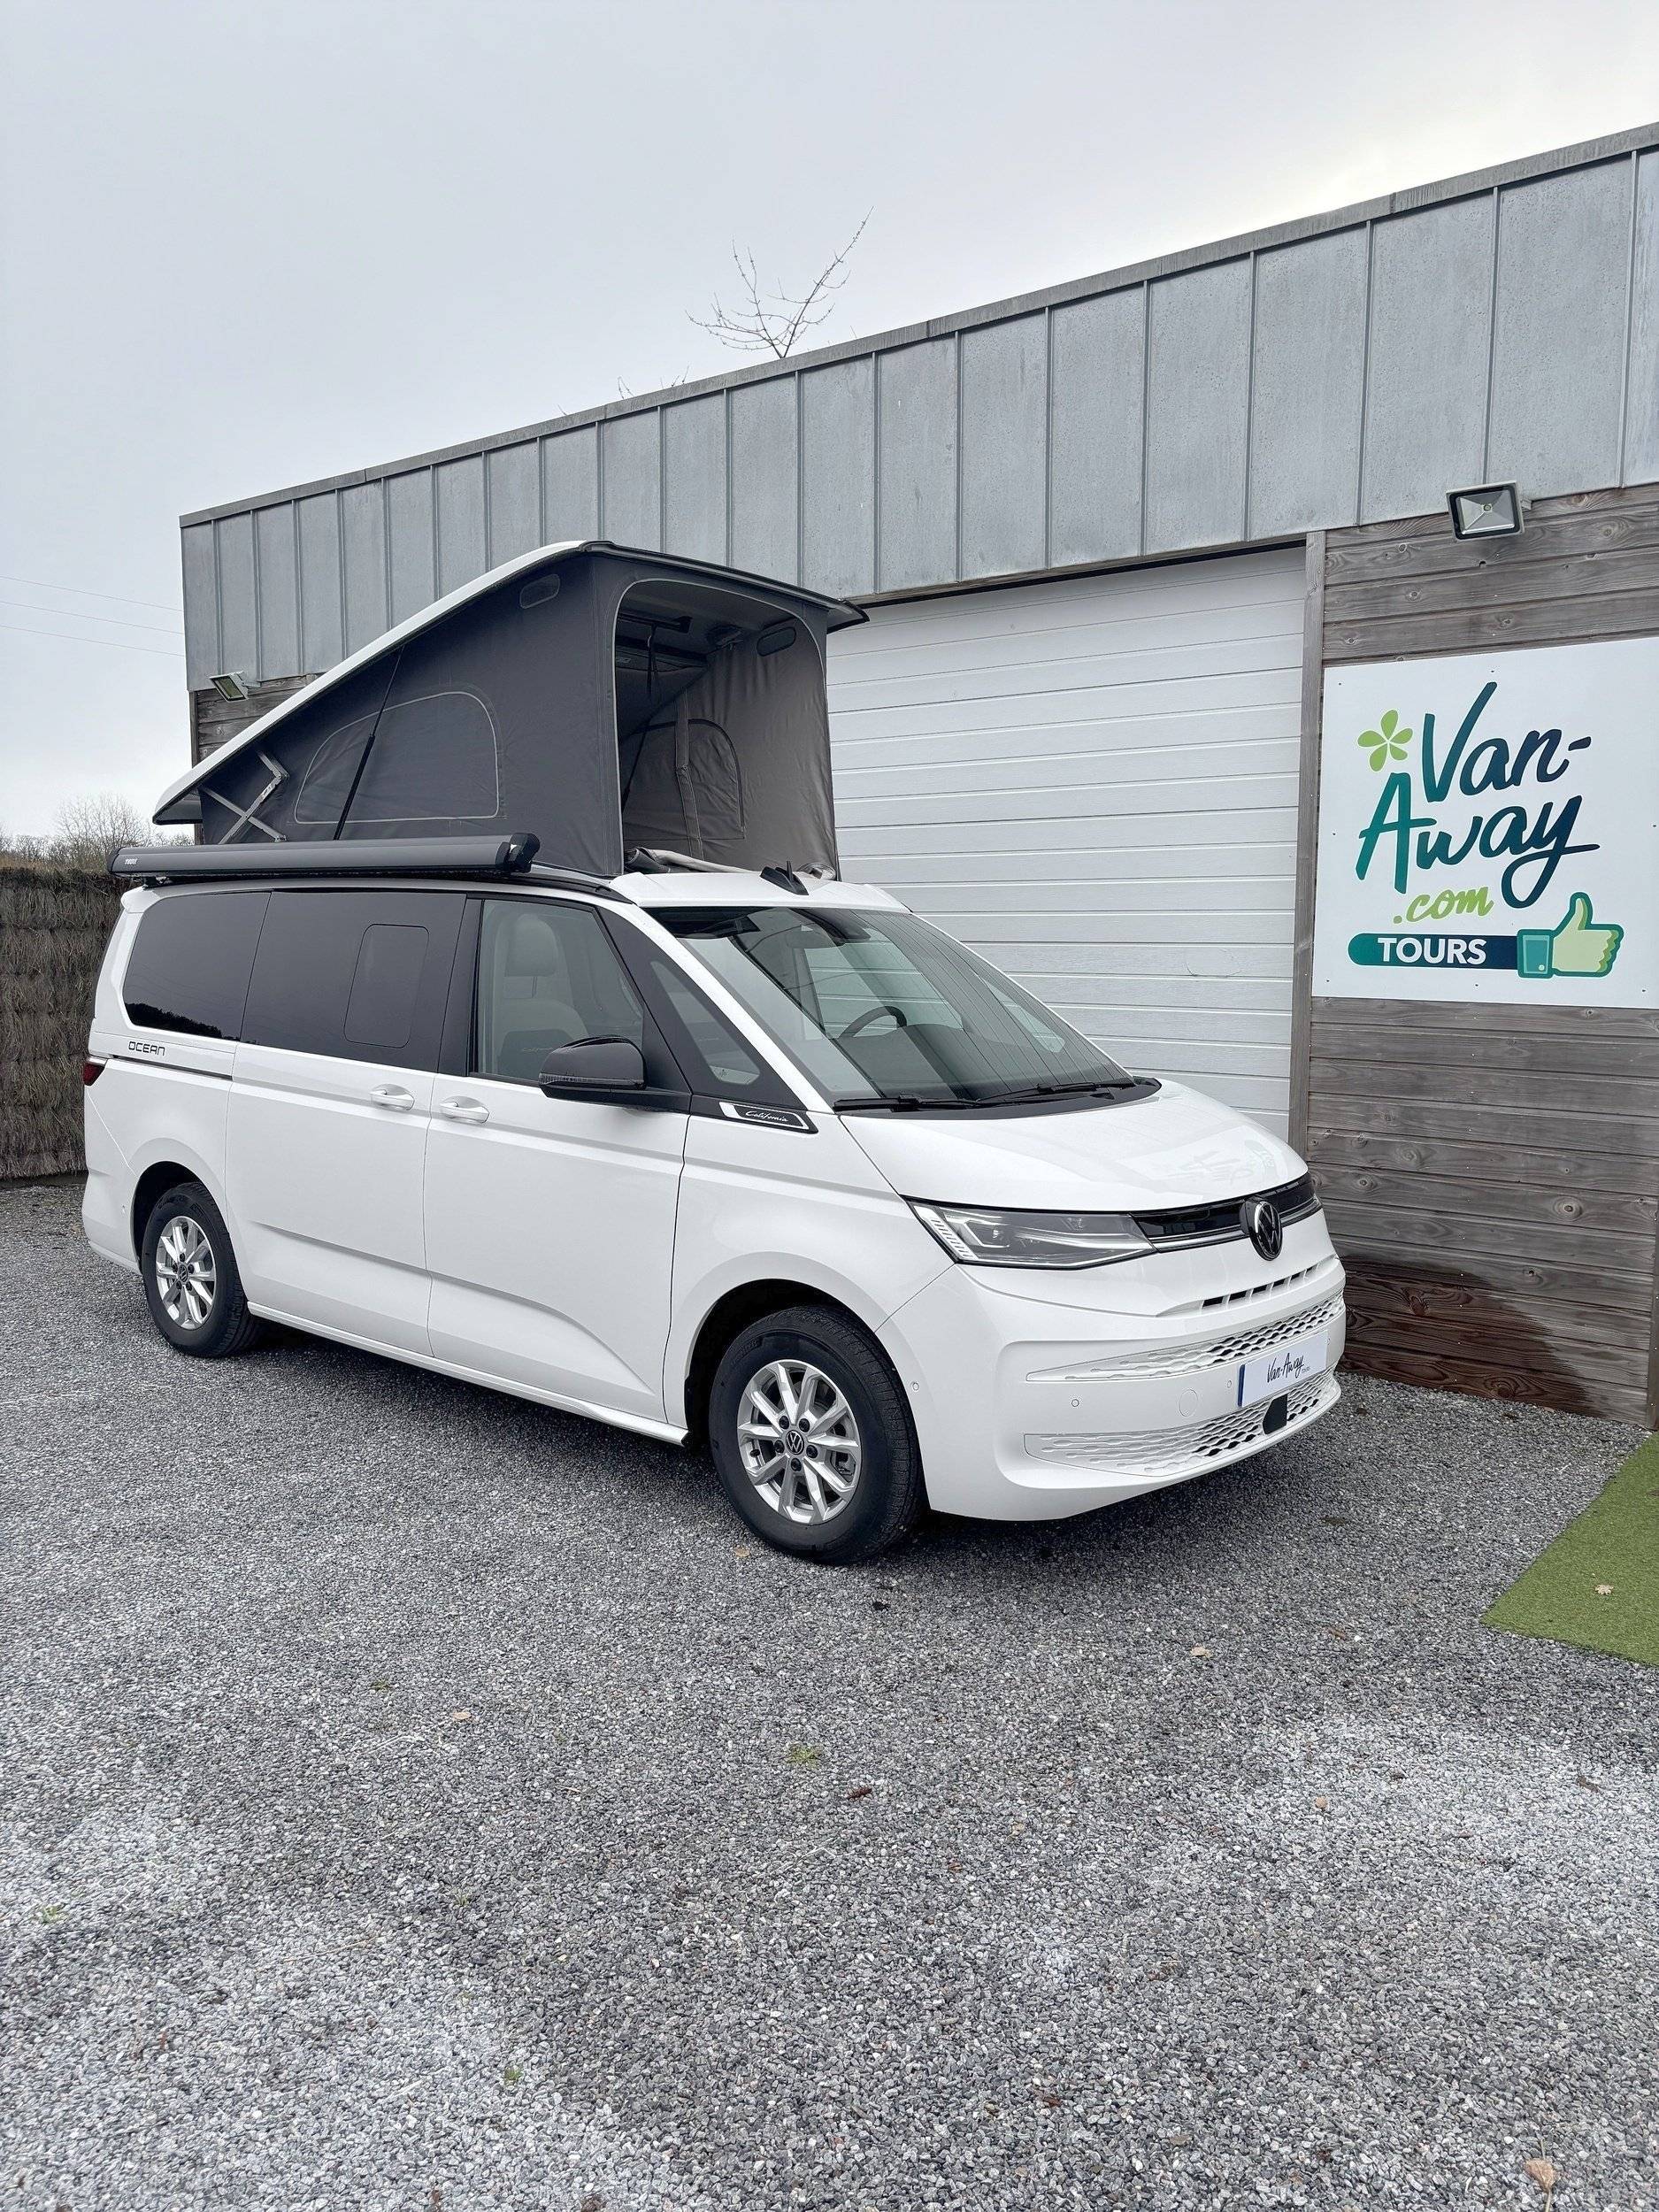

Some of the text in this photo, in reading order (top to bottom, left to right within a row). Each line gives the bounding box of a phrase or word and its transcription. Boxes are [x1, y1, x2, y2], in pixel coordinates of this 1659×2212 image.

[1422, 681, 1592, 803] Van-
[1356, 772, 1601, 910] Away
[1393, 886, 1494, 925] .com
[1378, 937, 1486, 965] TOURS
[128, 1041, 165, 1056] OCEAN
[745, 1110, 788, 1122] California
